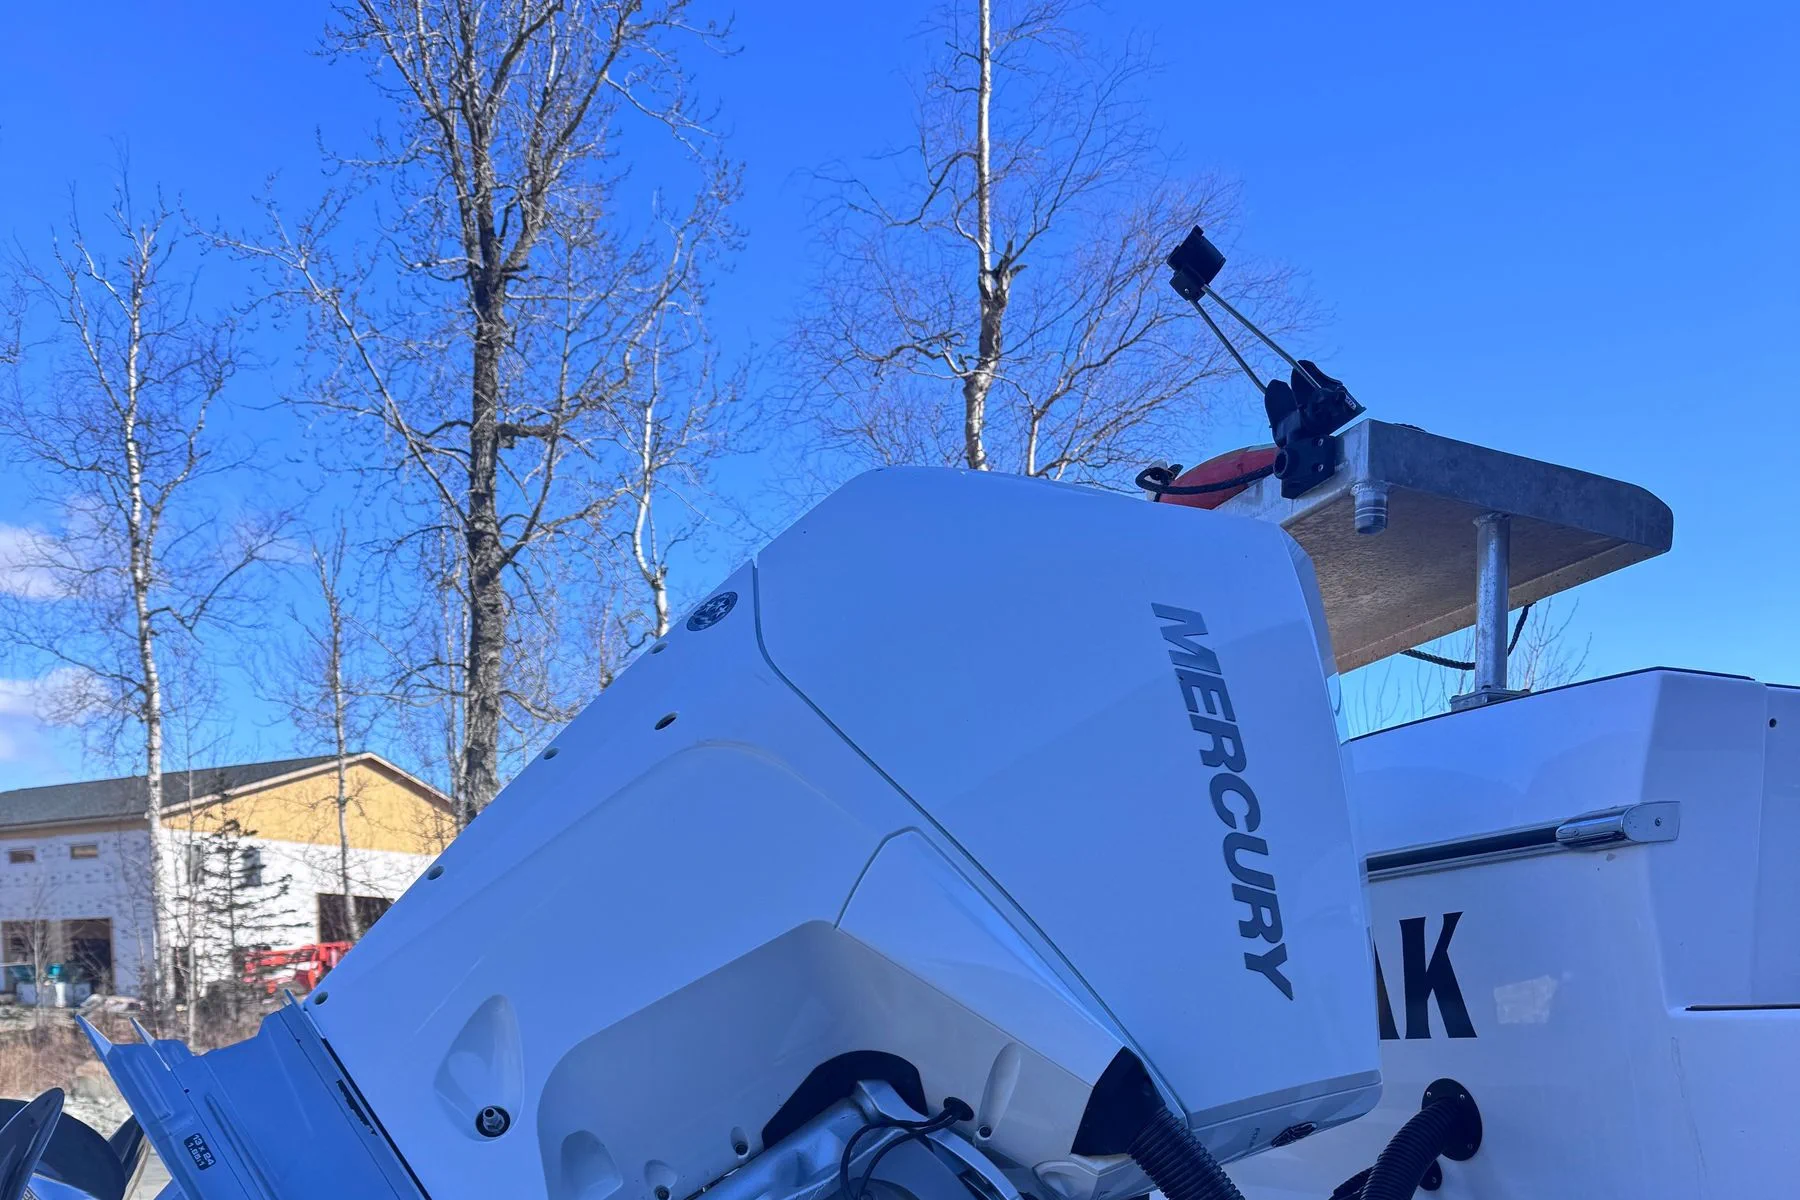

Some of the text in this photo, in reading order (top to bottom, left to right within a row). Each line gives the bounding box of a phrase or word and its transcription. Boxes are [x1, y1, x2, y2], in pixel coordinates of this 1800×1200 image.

[1151, 602, 1294, 1001] MERCURY
[1374, 911, 1478, 1040] K
[193, 1134, 203, 1146] 13
[202, 1152, 215, 1166] 24
